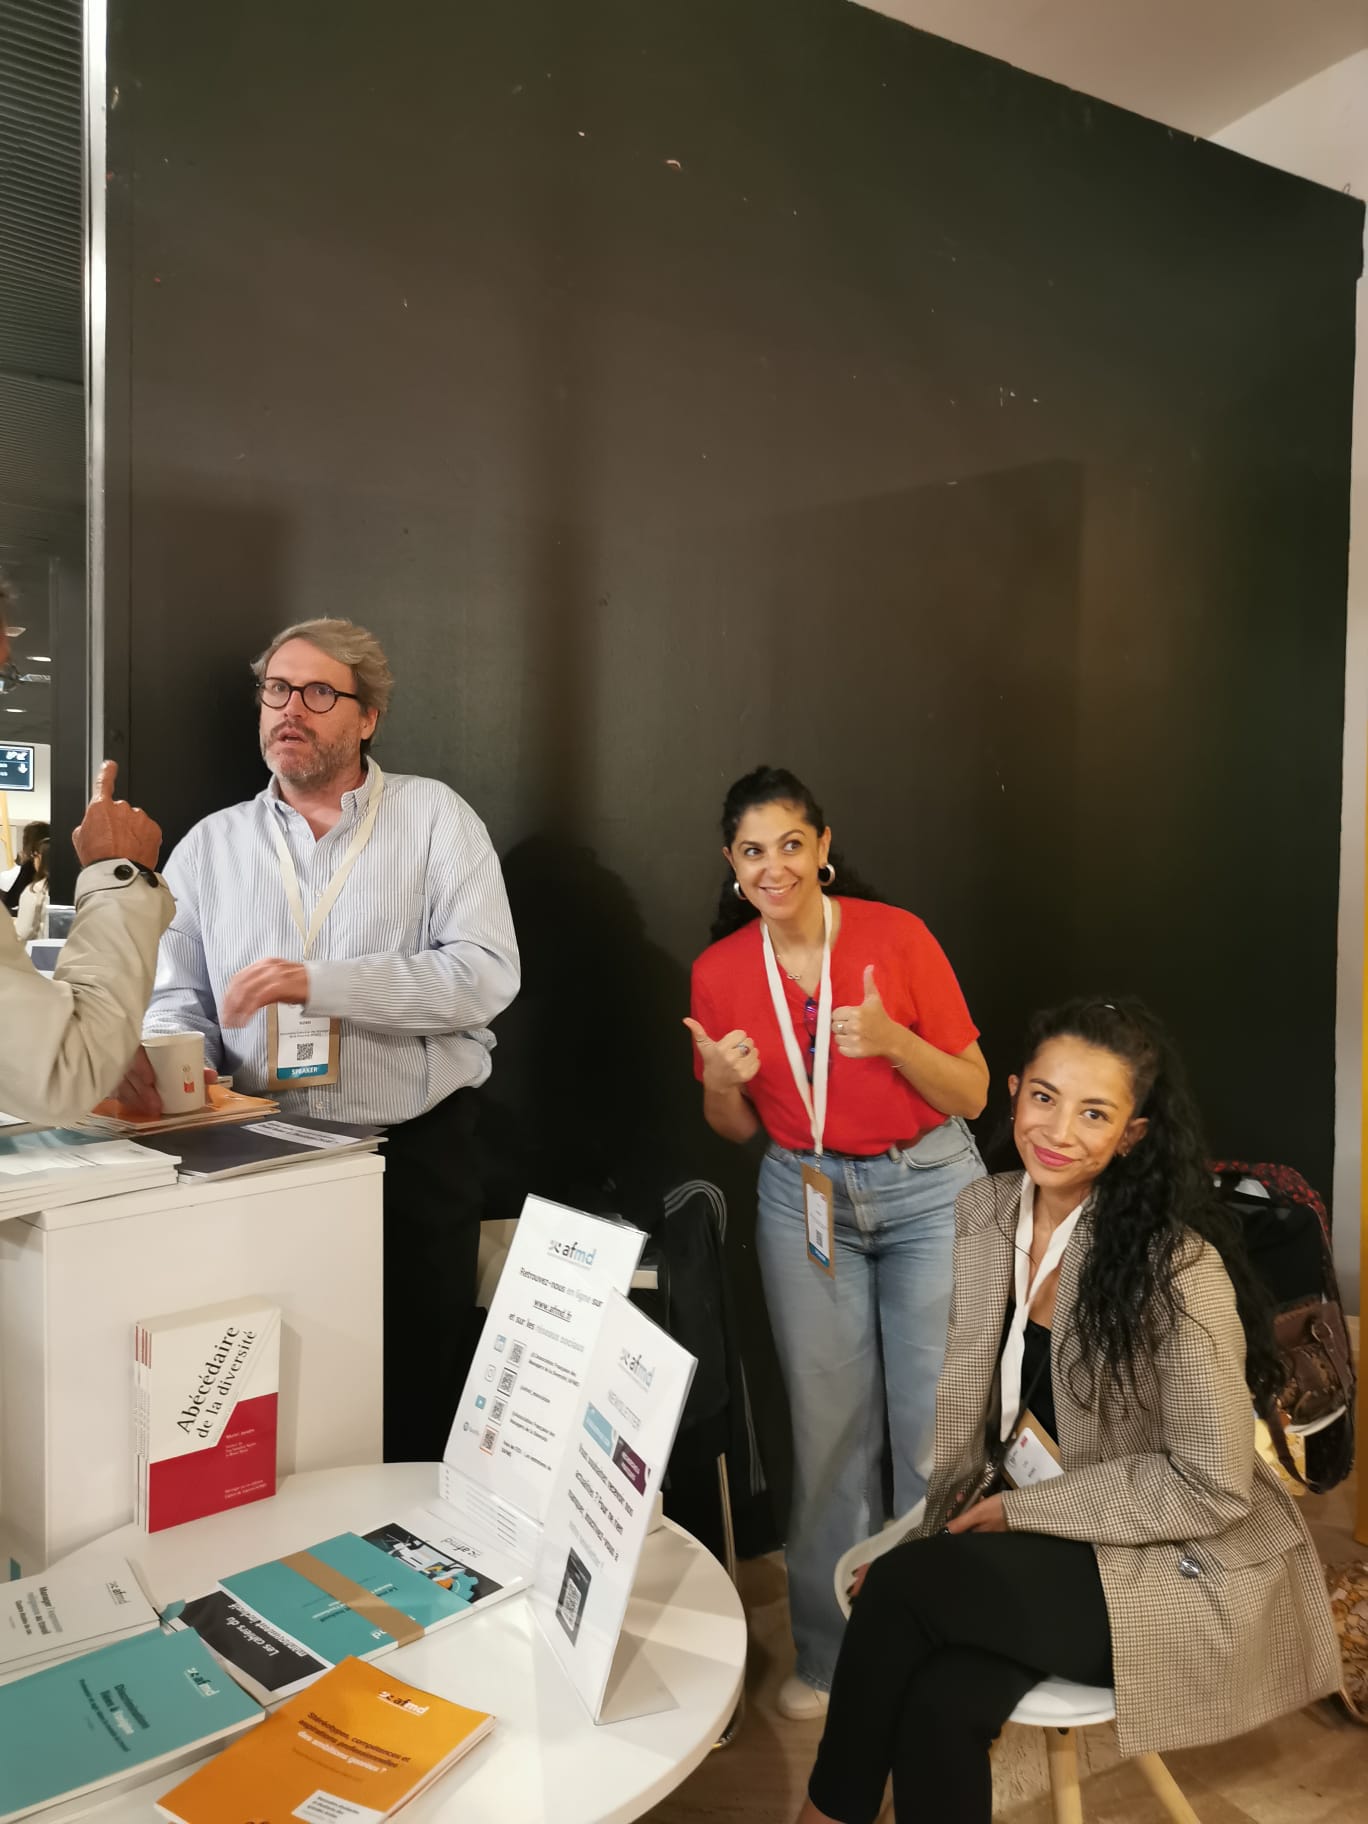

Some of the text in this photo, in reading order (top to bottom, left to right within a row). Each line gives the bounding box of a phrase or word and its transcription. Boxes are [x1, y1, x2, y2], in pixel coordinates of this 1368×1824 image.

[291, 1066, 318, 1075] SPEAKER
[562, 1242, 597, 1265] afmd
[591, 1297, 603, 1308] sur
[508, 1313, 516, 1321] et
[514, 1316, 526, 1326] sur
[525, 1320, 536, 1331] les
[177, 1327, 240, 1434] Abécédaire
[628, 1354, 656, 1387] afmd
[197, 1330, 257, 1438] de la diversité
[440, 1537, 470, 1553] afmd
[225, 1616, 280, 1656] Les cahiers du
[193, 1676, 220, 1697] afmd
[392, 1697, 429, 1715] afmd
